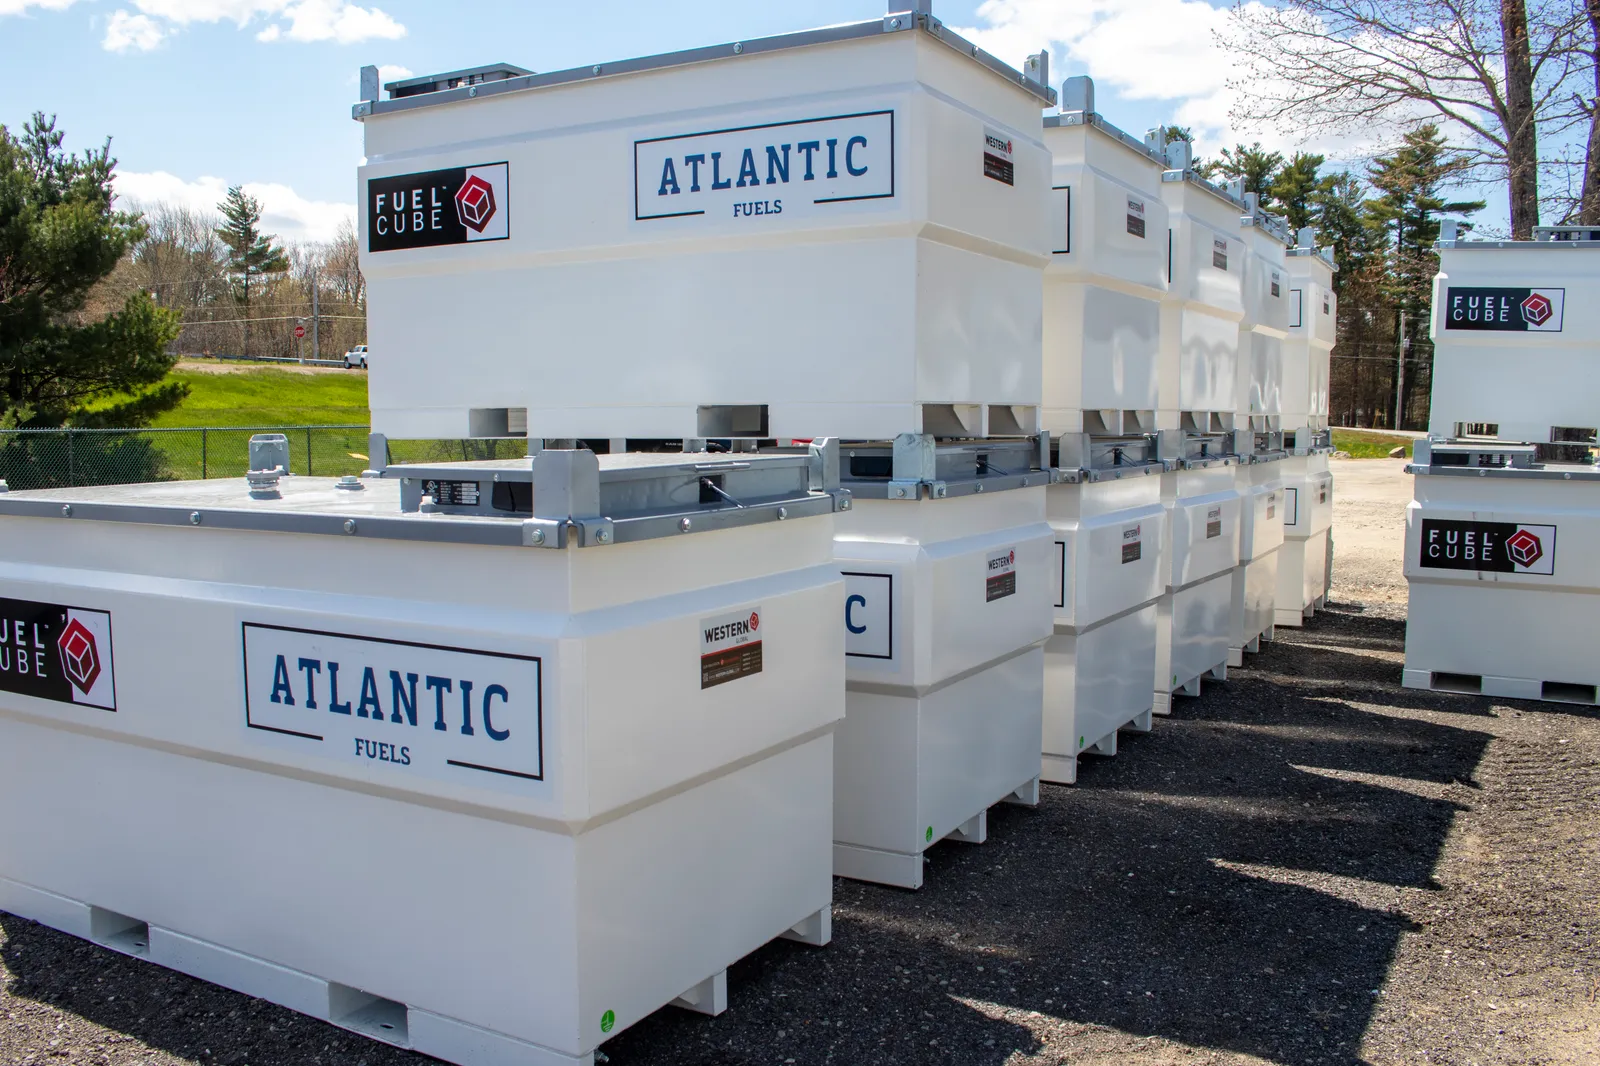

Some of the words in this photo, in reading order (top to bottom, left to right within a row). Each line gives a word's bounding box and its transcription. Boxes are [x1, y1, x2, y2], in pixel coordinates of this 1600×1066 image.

[985, 134, 1008, 154] WESTERN
[658, 135, 868, 196] ATLANTIC
[376, 187, 442, 214] FUEL
[733, 199, 782, 217] FUELS
[376, 209, 442, 235] CUBE
[1453, 296, 1510, 309] FUEL
[1453, 308, 1509, 322] CUBE
[1429, 529, 1493, 546] FUEL
[987, 555, 1010, 571] WESTERN
[1429, 544, 1492, 561] CUBE
[845, 594, 867, 634] C
[704, 619, 749, 643] WESTERN
[270, 654, 510, 741] ATLANTIC
[354, 738, 411, 765] FUELS
